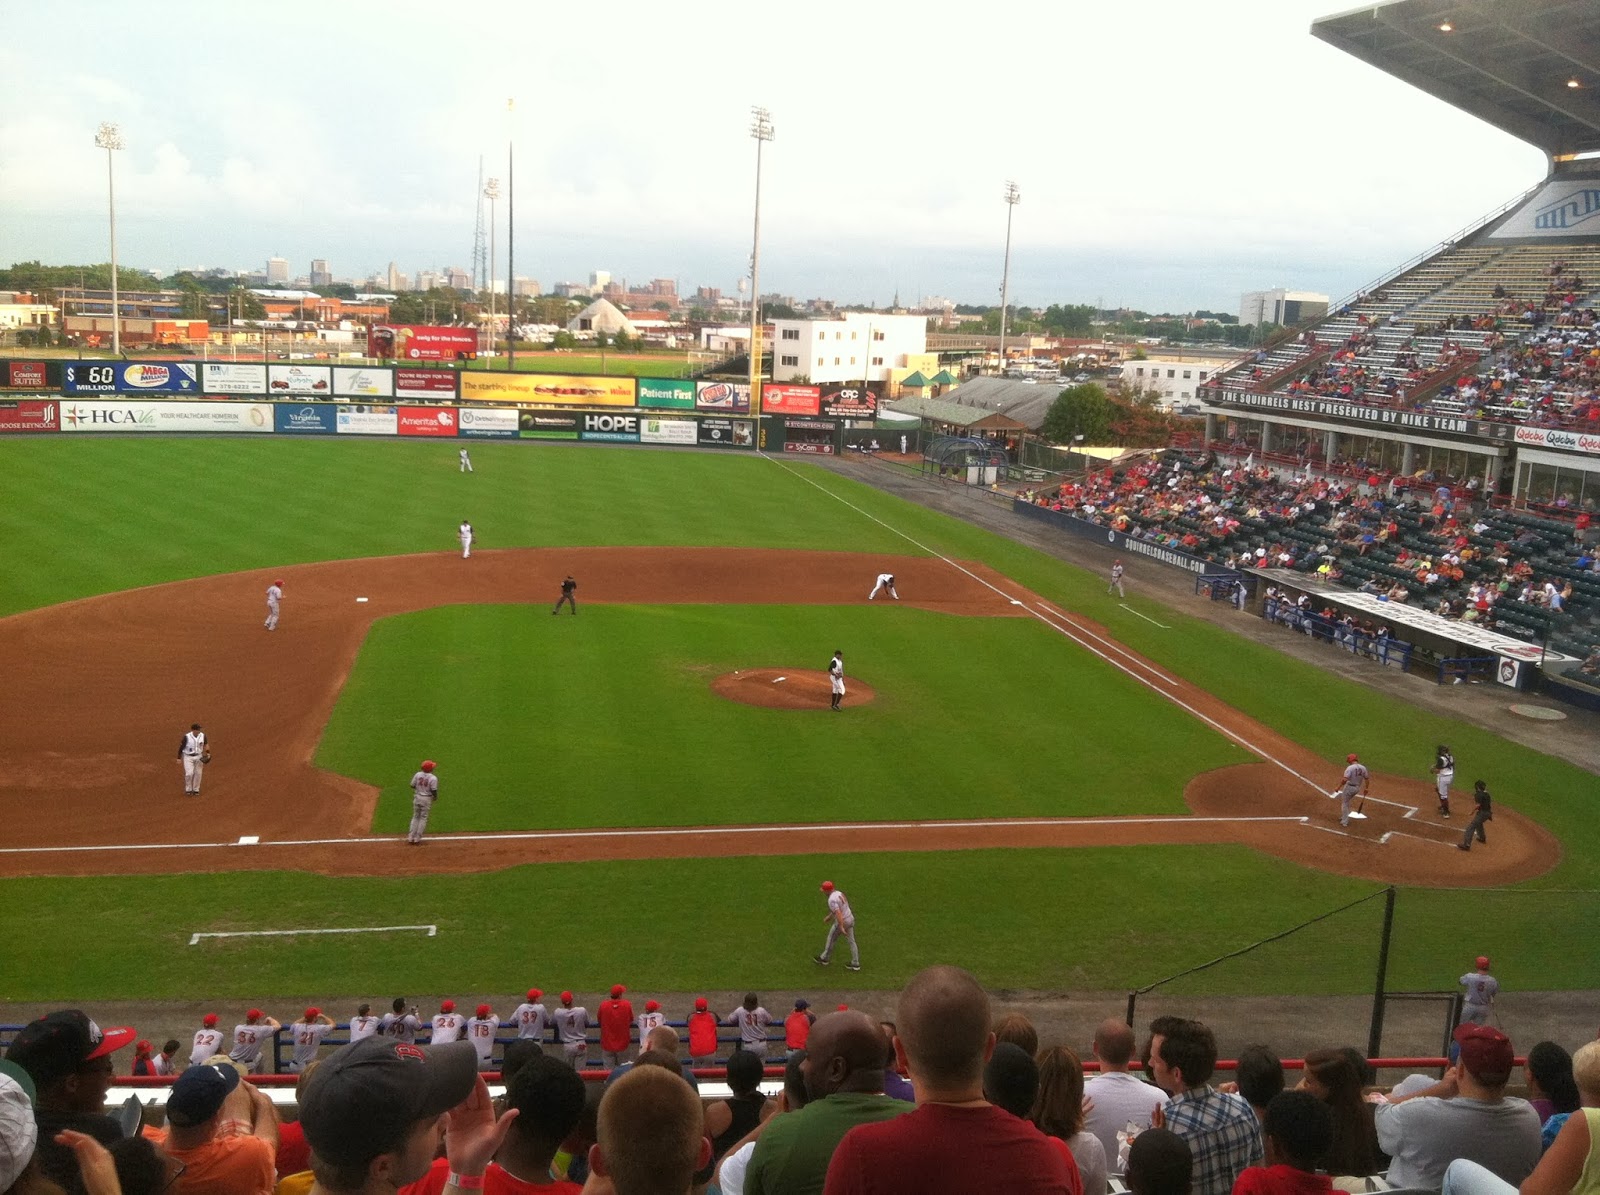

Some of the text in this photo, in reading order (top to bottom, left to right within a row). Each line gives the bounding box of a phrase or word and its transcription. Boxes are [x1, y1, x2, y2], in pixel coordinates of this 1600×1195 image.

[89, 367, 113, 383] 60
[141, 366, 168, 375] MEGA
[464, 382, 477, 390] The
[478, 382, 507, 393] starting
[641, 388, 672, 398] Patient
[674, 389, 692, 400] First
[91, 410, 137, 424] HCA
[1222, 391, 1467, 432] THE SQUIRRELS NEST PRESENTED BY NIKE TEAM
[401, 417, 439, 426] Ameritas
[585, 414, 637, 432] HOPE
[1516, 427, 1545, 442] Qdoba
[1546, 430, 1576, 446] Qdoba
[1125, 538, 1205, 574] SQUIRRELSBASEBALL.COM
[522, 1011, 538, 1024] 39
[567, 1016, 575, 1028] 4
[643, 1016, 657, 1028] 15
[359, 1020, 368, 1031] 7
[474, 1024, 489, 1037] 18
[196, 1033, 215, 1045] 22
[300, 1031, 314, 1045] 21
[395, 1042, 425, 1063] B
